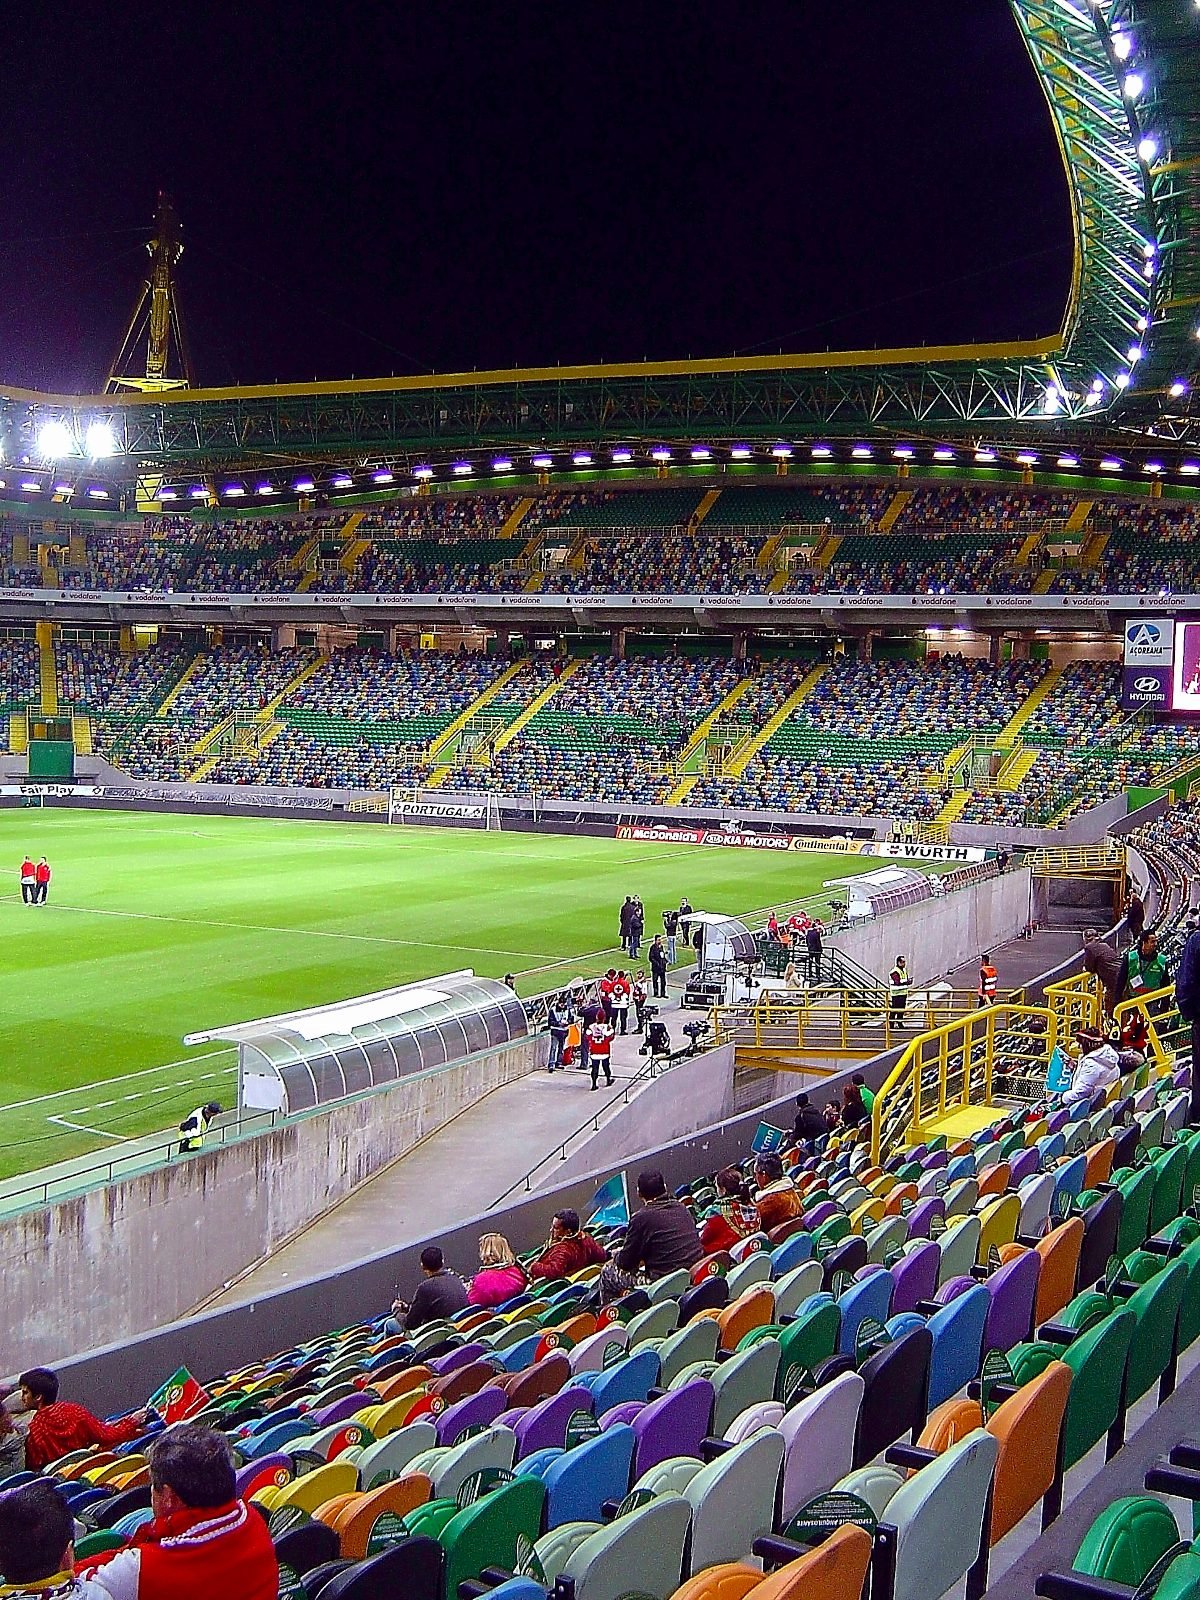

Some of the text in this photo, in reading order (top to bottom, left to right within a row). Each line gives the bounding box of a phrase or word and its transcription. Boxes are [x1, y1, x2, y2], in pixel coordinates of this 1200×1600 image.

[2, 590, 34, 598] vodafone
[70, 592, 102, 600] vodafone
[261, 595, 291, 603] vodafone
[574, 597, 606, 605] vodafone
[640, 597, 673, 605] vodafone
[708, 597, 741, 605] vodafone
[777, 597, 812, 605] vodafone
[848, 597, 883, 605] vodafone
[921, 597, 957, 606] vodafone
[995, 597, 1033, 606] vodafone
[1073, 597, 1110, 606] vodafone
[1148, 597, 1186, 606] vodafone
[632, 828, 698, 842] McDonald's
[723, 834, 742, 845] KIA
[743, 836, 789, 848] MOTORS
[794, 839, 849, 851] Continental
[905, 846, 968, 859] WÜRTH
[761, 1129, 776, 1150] tmn
